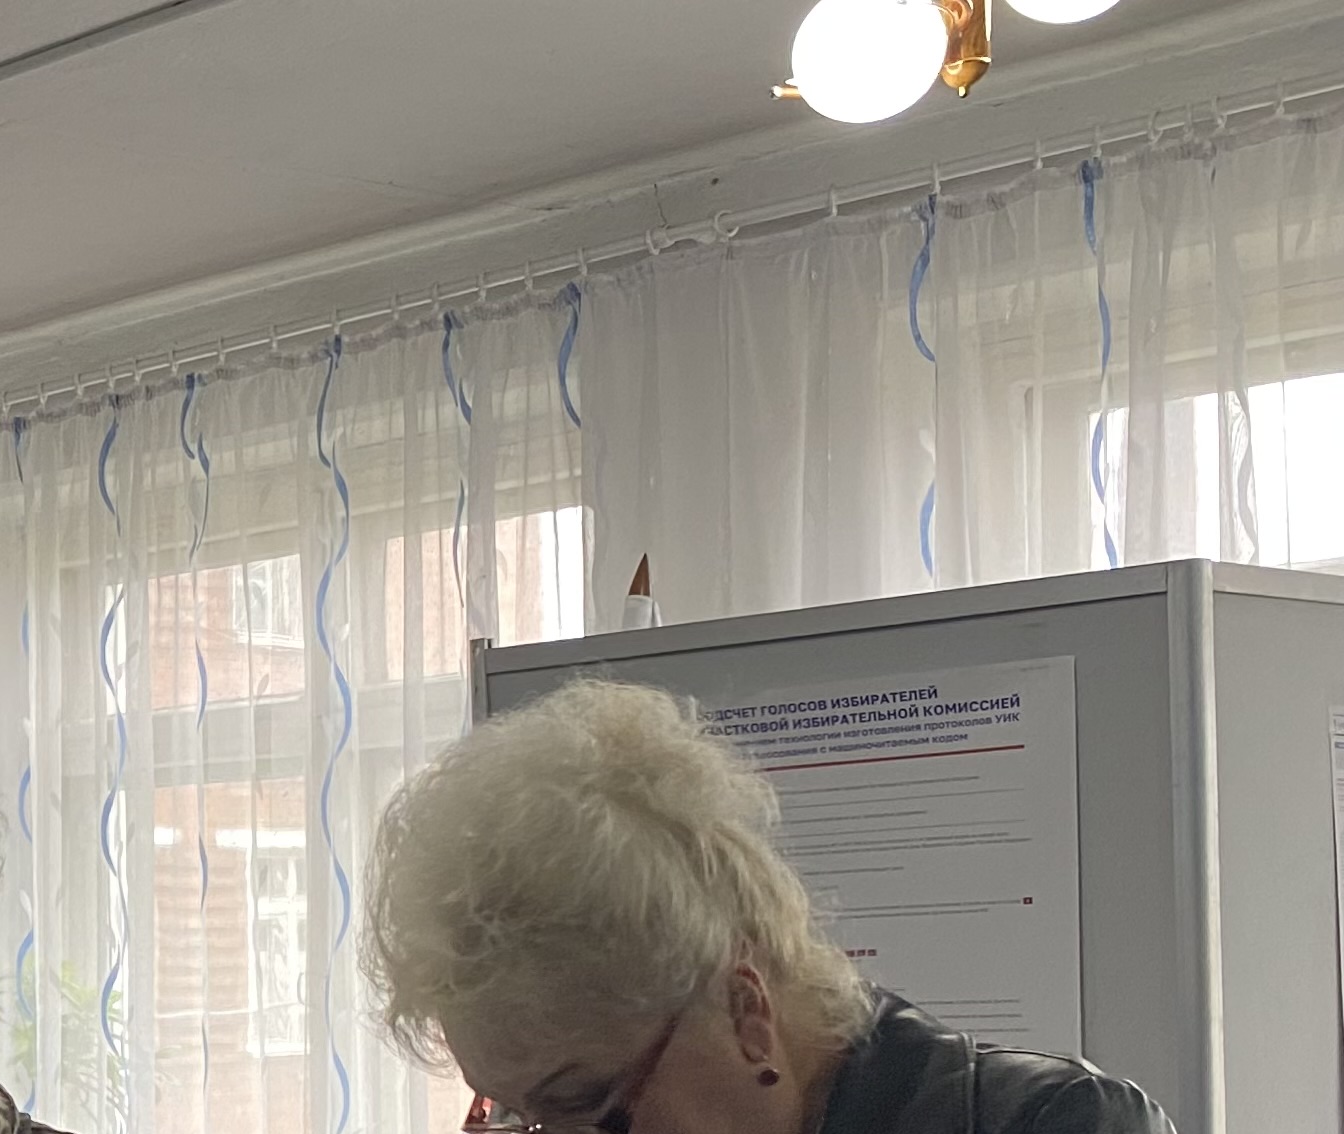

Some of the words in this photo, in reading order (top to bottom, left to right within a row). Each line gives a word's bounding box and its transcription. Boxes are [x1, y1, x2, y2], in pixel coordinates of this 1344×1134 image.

[760, 699, 828, 717] ГОЛОСОВ
[830, 685, 939, 709] ИЗБИРАТЕЛЕЙ
[792, 703, 919, 730] ИЗБИРАТЕЛЬНОЙ
[923, 693, 1021, 718] КОМИССИЕЙ
[778, 731, 842, 744] технологии
[843, 721, 922, 739] изготовления
[923, 716, 993, 732] протоколов
[994, 712, 1021, 725] УИК
[931, 733, 969, 746] кодом
